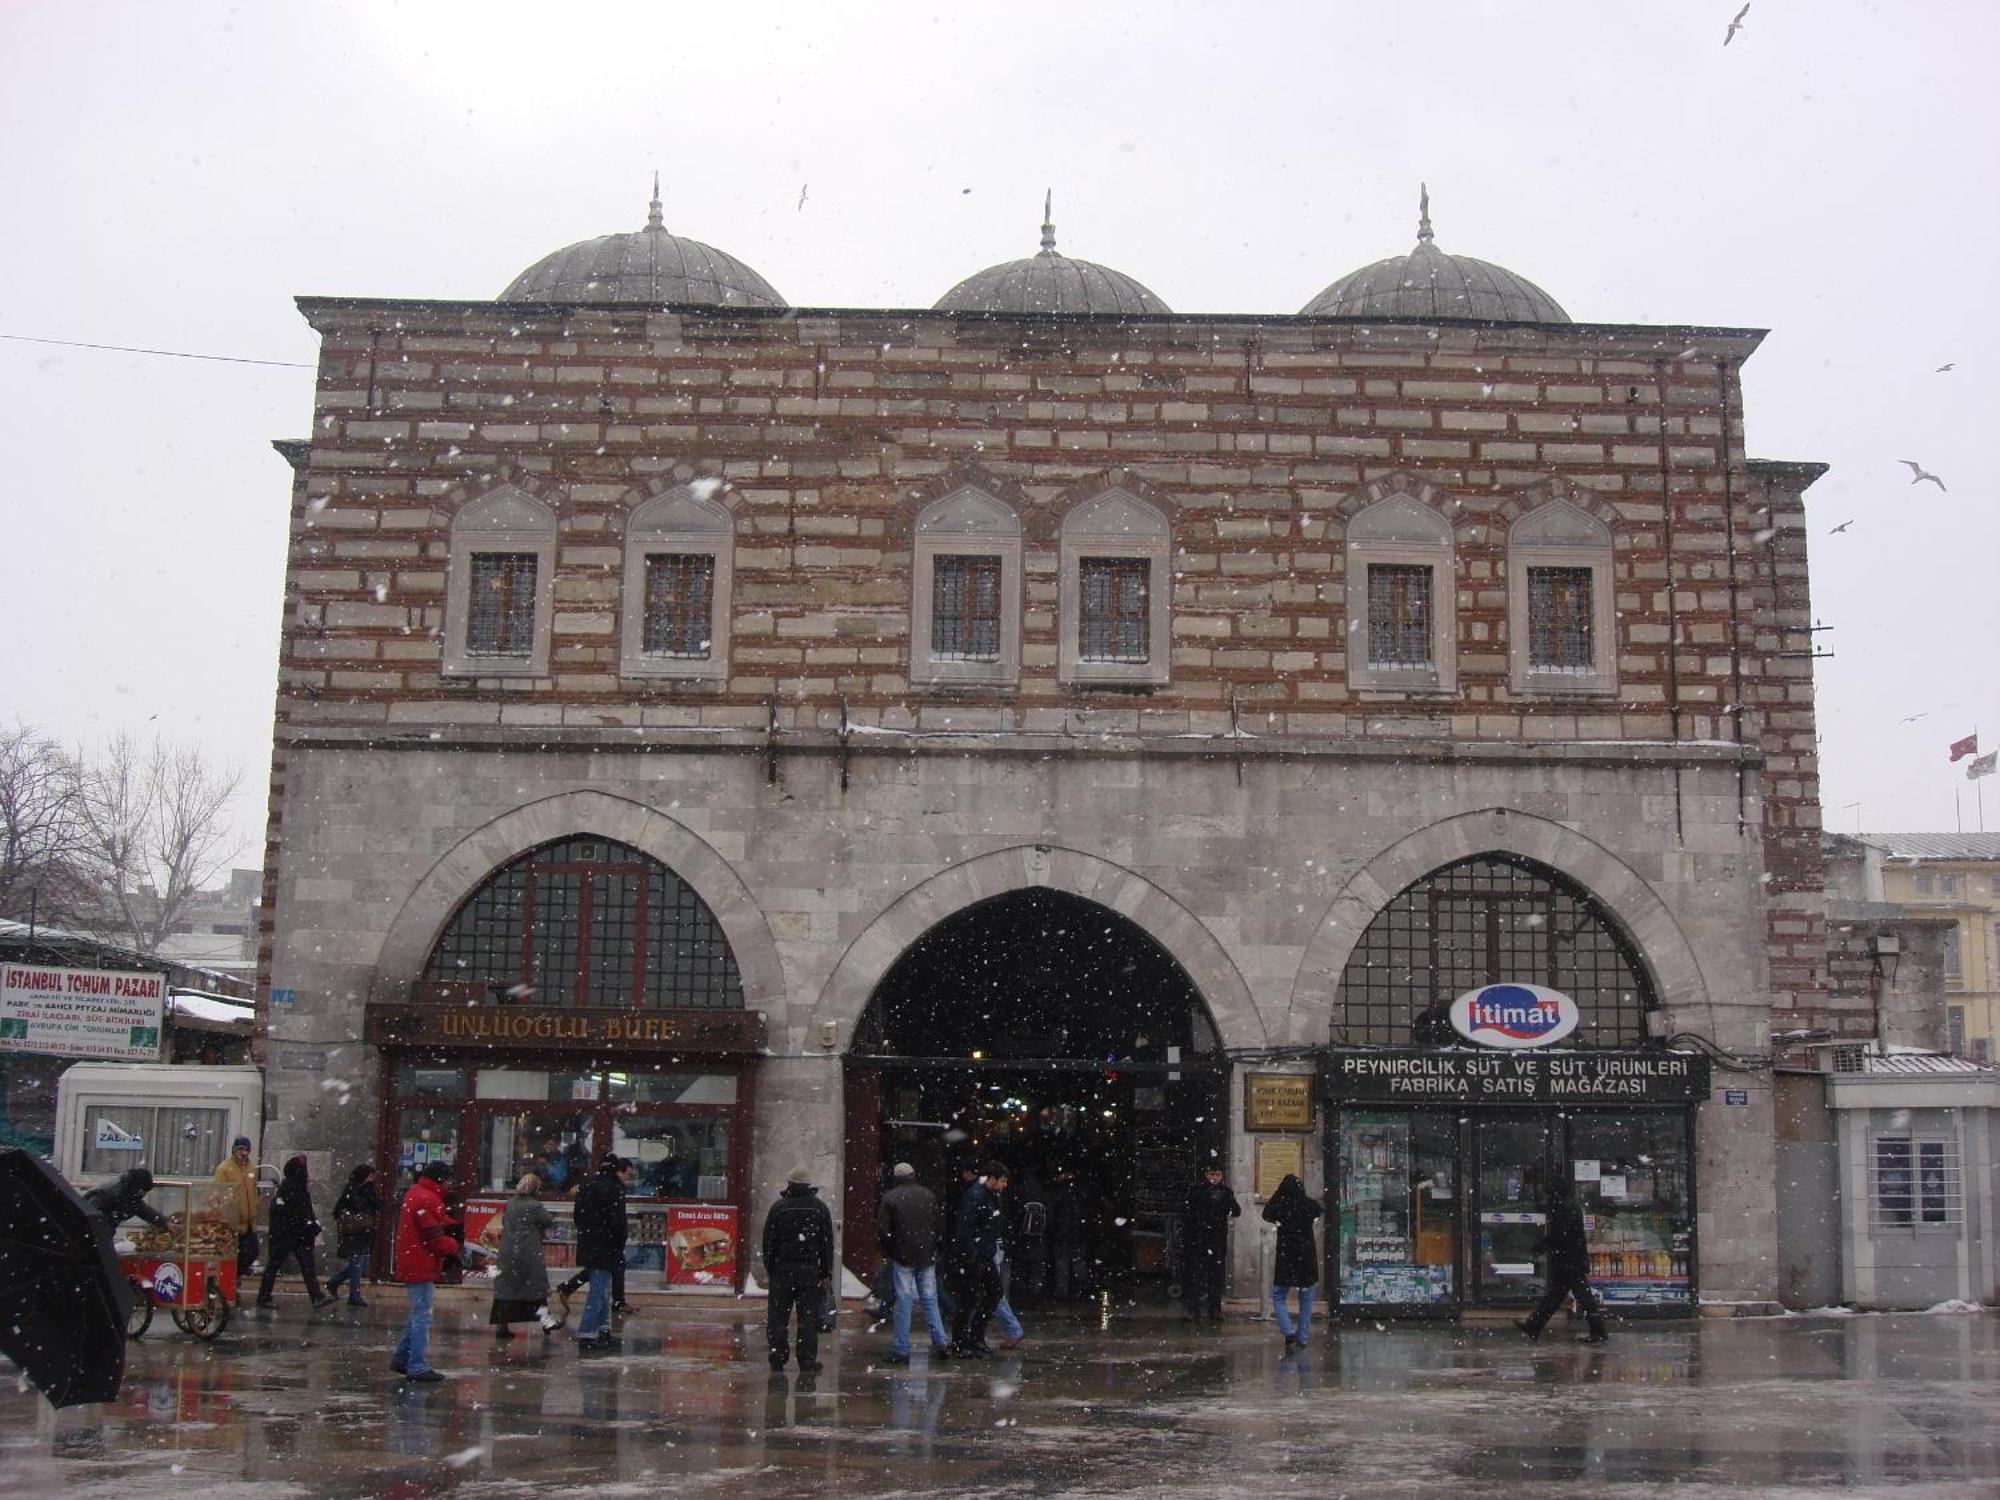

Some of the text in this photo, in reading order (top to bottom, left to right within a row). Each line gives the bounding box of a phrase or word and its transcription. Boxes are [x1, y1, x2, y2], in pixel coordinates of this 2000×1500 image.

[6, 966, 63, 991] İSTANBUL
[115, 977, 160, 998] PAZARI
[442, 1008, 676, 1040] ÜNLÜOĞLU BÜFE
[1475, 1004, 1556, 1024] itimat
[30, 1022, 63, 1032] AVRUPA
[1466, 1057, 1502, 1076] SÜT
[1515, 1060, 1538, 1076] VE
[1550, 1057, 1586, 1076] SÜT
[1597, 1057, 1688, 1076] ÜRÜNLERİ
[1390, 1075, 1647, 1097] FABRİKA SATIŞ MAĞAZASI
